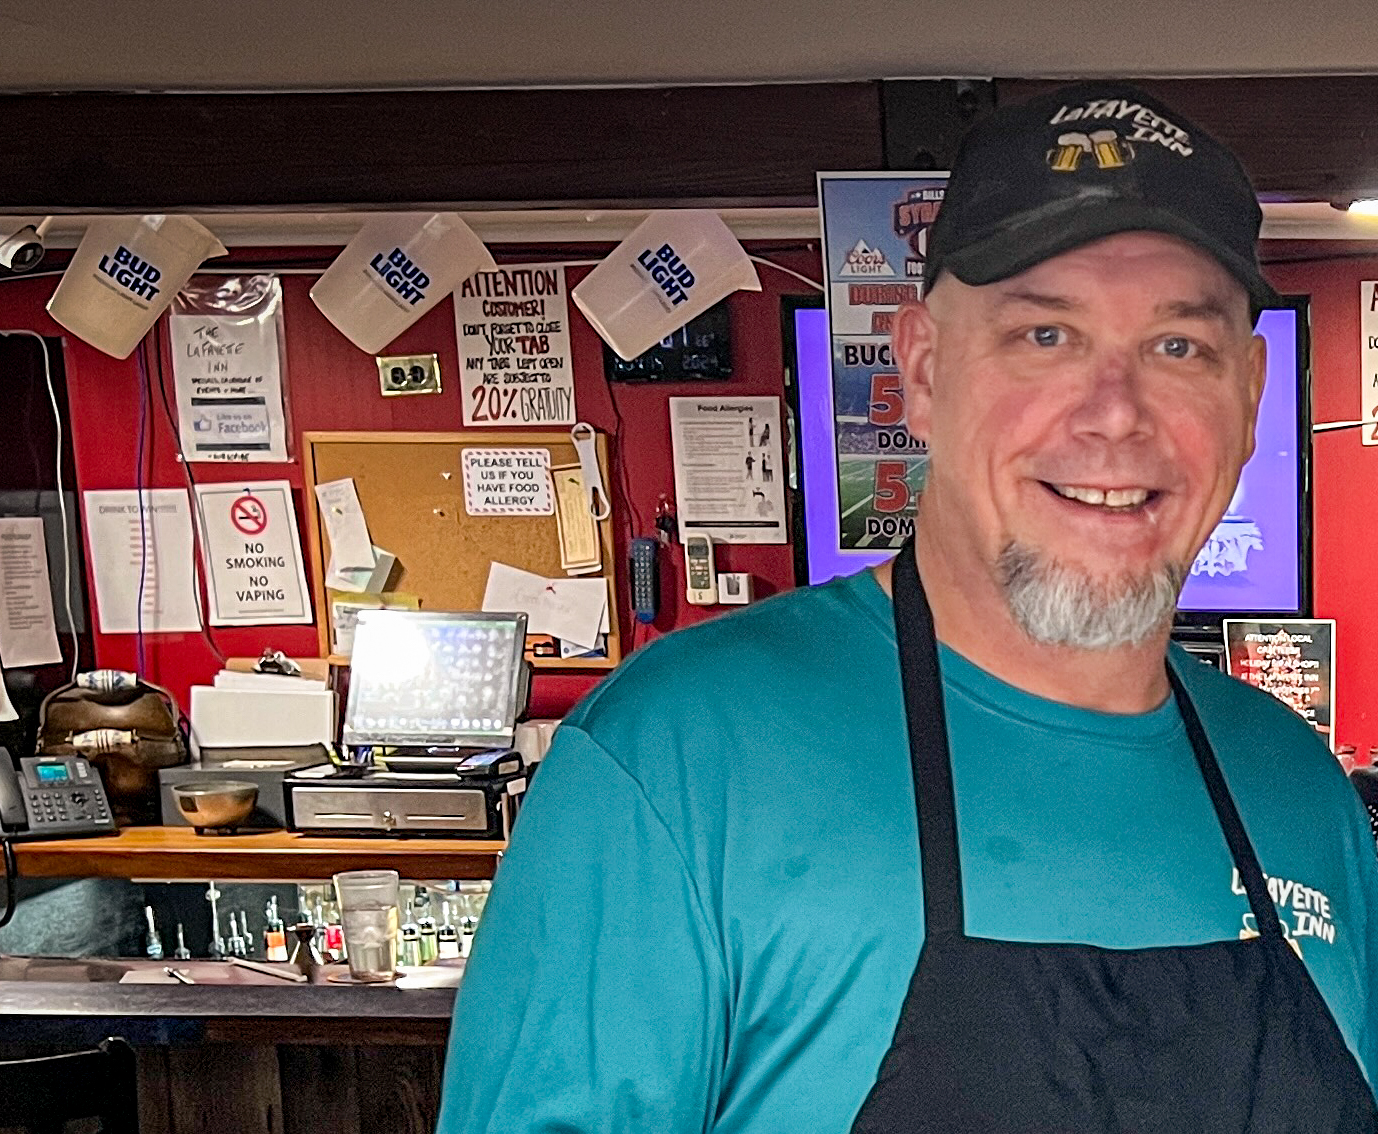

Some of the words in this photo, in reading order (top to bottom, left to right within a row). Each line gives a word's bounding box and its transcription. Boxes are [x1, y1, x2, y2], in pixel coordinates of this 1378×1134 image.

[1125, 127, 1194, 158] INN
[113, 245, 162, 284] BUD
[656, 243, 696, 288] BUD
[847, 250, 886, 265] Coors
[388, 247, 430, 289] BUD
[850, 265, 882, 274] LIGHT
[98, 254, 160, 301] LIGHT
[369, 252, 426, 305] LIGHT
[461, 269, 559, 298] ATTENTION
[637, 249, 688, 306] LIGHT
[194, 325, 219, 340] THE
[484, 335, 516, 356] YOUR
[515, 335, 550, 355] TAB
[207, 360, 228, 374] INN
[466, 357, 484, 370] ANY
[516, 357, 538, 369] LEFT
[539, 357, 564, 369] OPEN
[471, 385, 518, 422] 20%
[519, 386, 573, 422] GRATUITY
[217, 420, 268, 434] Facebook
[877, 431, 927, 450] DOM
[470, 457, 512, 468] PLEASE
[515, 457, 542, 468] TELL
[480, 470, 496, 480] US
[498, 471, 507, 480] IF
[510, 471, 534, 480] YOU
[477, 483, 506, 493] HAVE
[509, 483, 540, 493] FOOD
[484, 496, 536, 506] ALLERGY
[867, 519, 915, 536] DOM
[245, 543, 264, 554] NO
[225, 556, 285, 570] SMOKING
[249, 575, 269, 587] NO
[236, 589, 285, 602] VAPING
[1231, 866, 1332, 919] LAYETTE
[1291, 910, 1335, 944] INN
